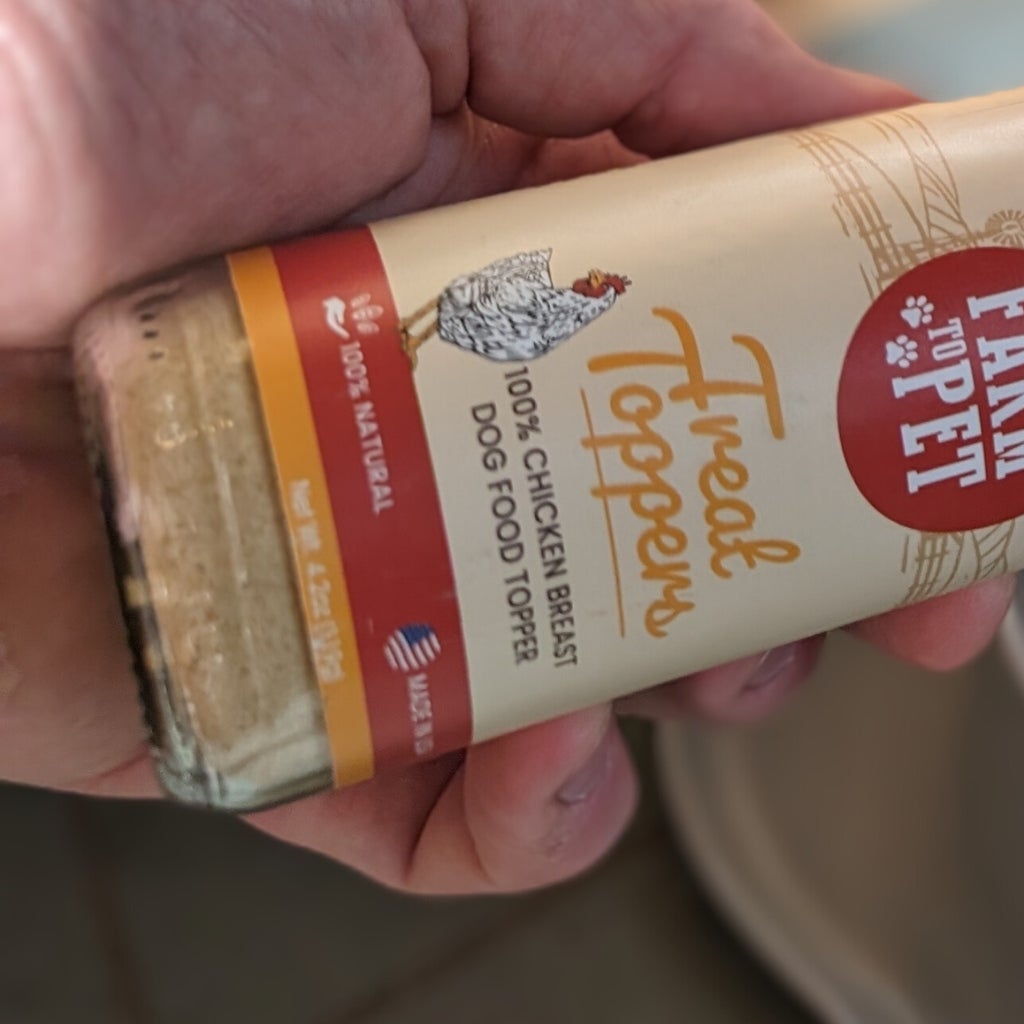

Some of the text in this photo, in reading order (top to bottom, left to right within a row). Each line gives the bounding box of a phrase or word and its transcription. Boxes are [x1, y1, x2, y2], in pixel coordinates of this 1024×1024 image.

[340, 341, 394, 516] 100% NATURAL
[891, 358, 987, 494] PET
[927, 317, 968, 361] TO
[471, 402, 539, 666] DOG FOOD TOPPER
[504, 366, 578, 668] 100% CHICKEN BREAST
[580, 307, 708, 638] Toppers
[668, 335, 800, 579] Treat
[407, 673, 432, 722] MADE
